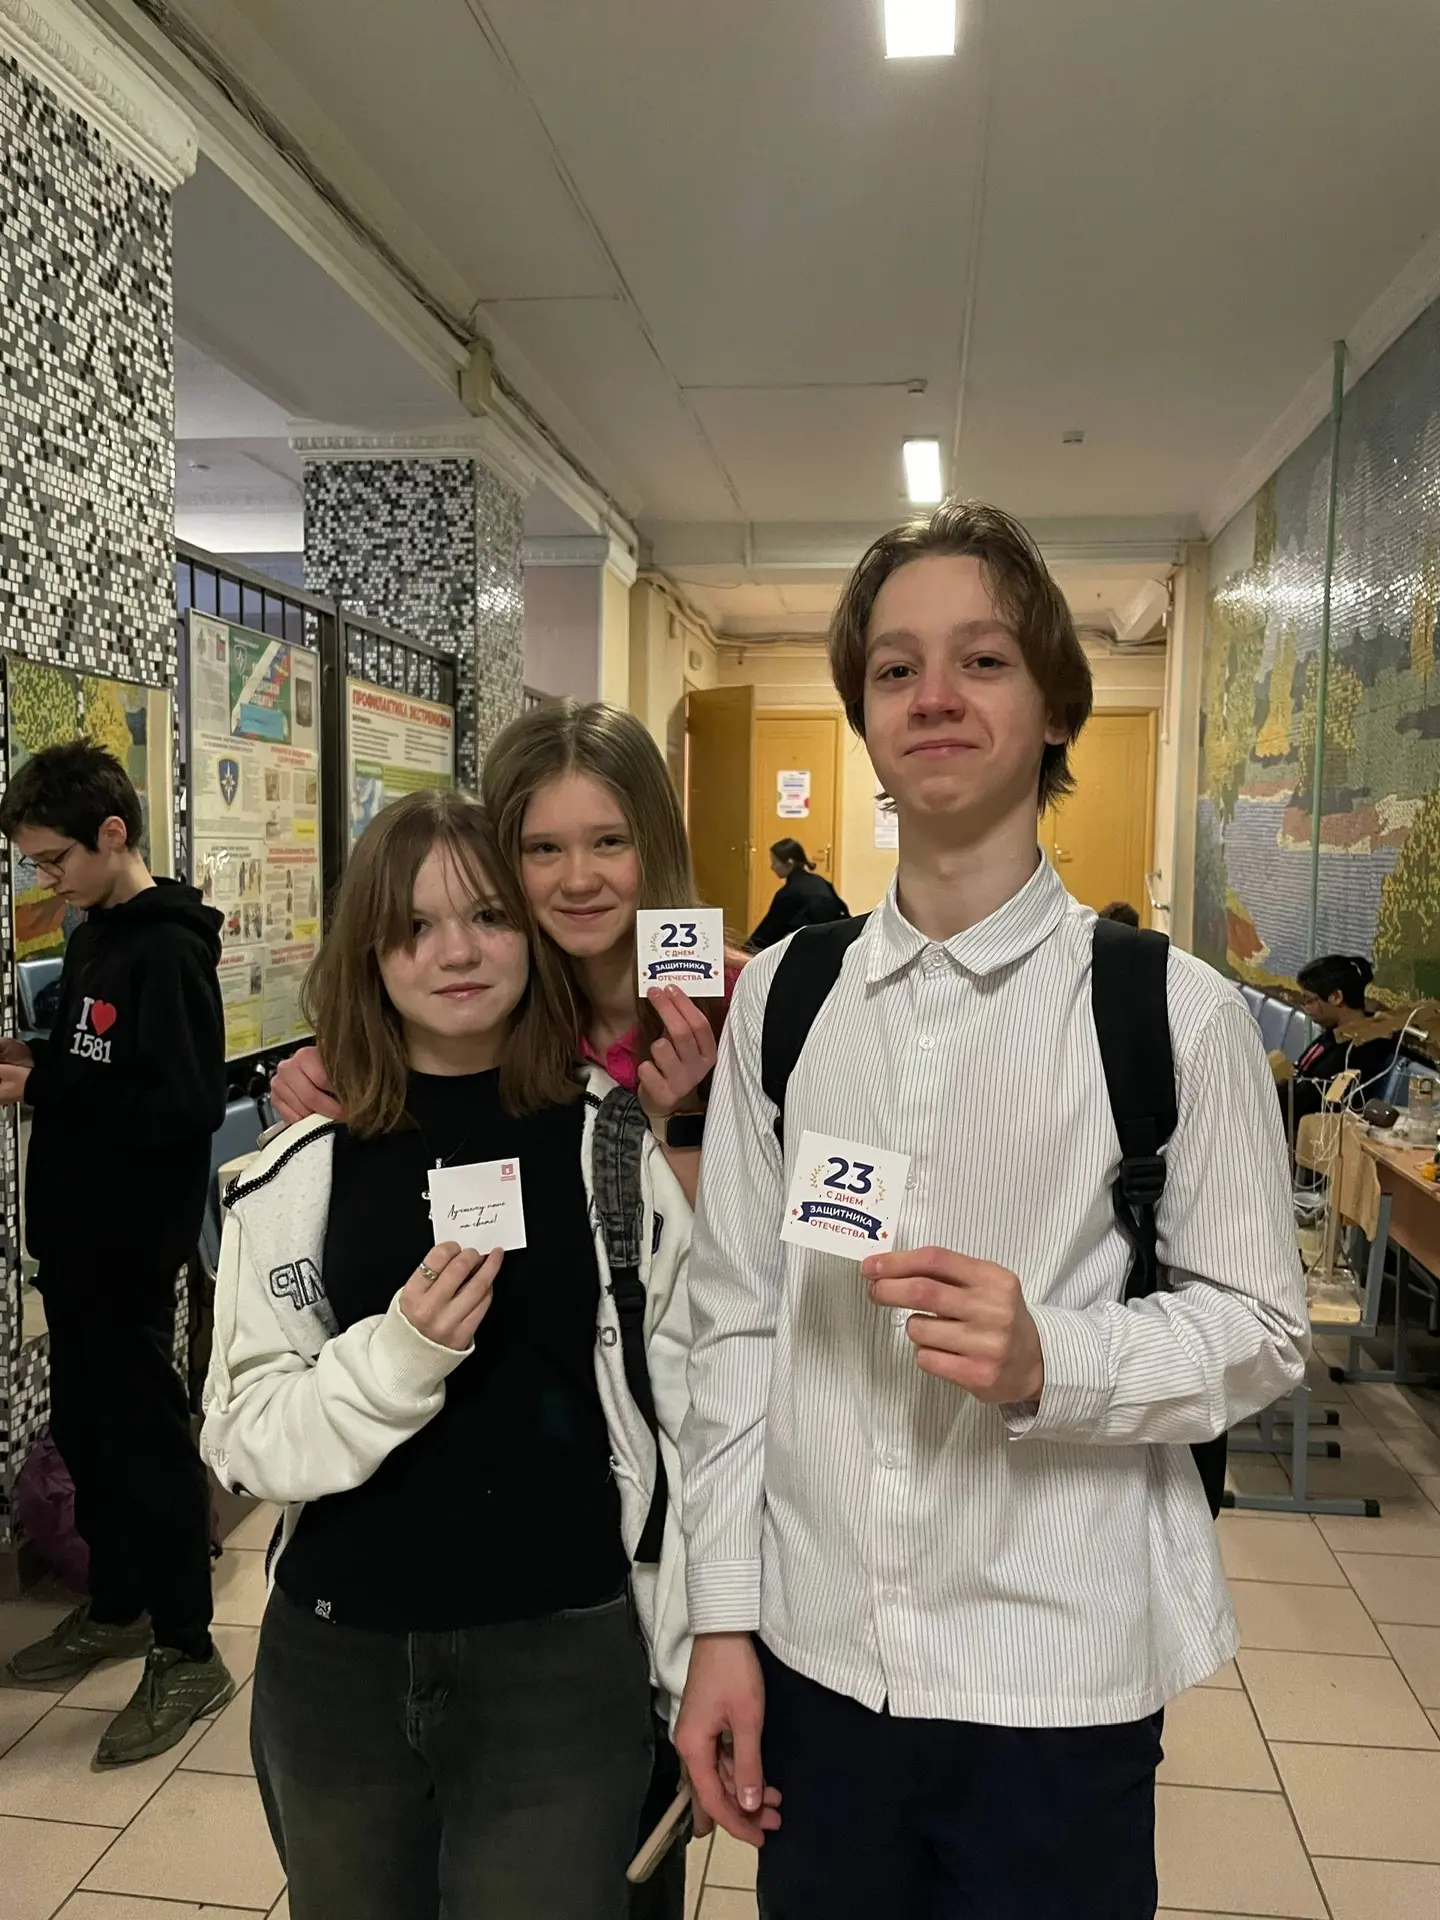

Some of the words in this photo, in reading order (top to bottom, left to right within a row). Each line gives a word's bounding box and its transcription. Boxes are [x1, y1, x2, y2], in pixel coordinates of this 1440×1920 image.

[660, 923, 698, 948] 23
[672, 950, 695, 958] ДНЕМ
[655, 962, 705, 972] ЗАЩИТНИКА
[76, 996, 95, 1030] I
[69, 1032, 112, 1063] 1581
[823, 1156, 874, 1195] 23
[826, 1190, 833, 1199] С
[834, 1192, 864, 1206] ДНЕМ
[810, 1205, 873, 1228] ЗАЩИТНИКА
[810, 1219, 866, 1239] ОТЕЧЕСТВА
